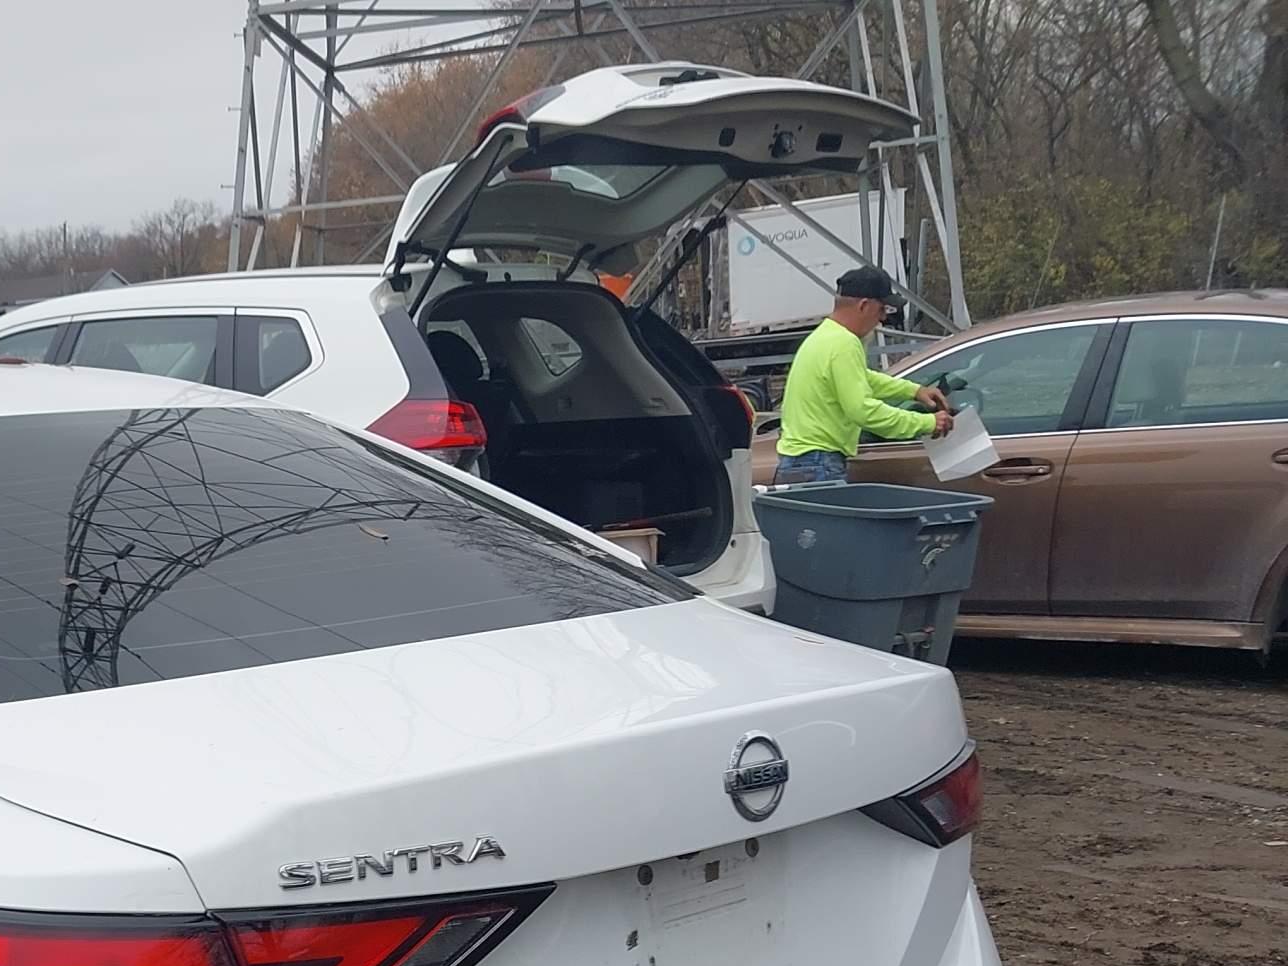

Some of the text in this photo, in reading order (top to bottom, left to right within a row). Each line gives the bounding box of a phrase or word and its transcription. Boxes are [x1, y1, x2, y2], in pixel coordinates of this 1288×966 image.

[762, 228, 808, 243] VOQUA
[732, 762, 788, 790] NISSAN
[278, 833, 506, 889] SENTRA
